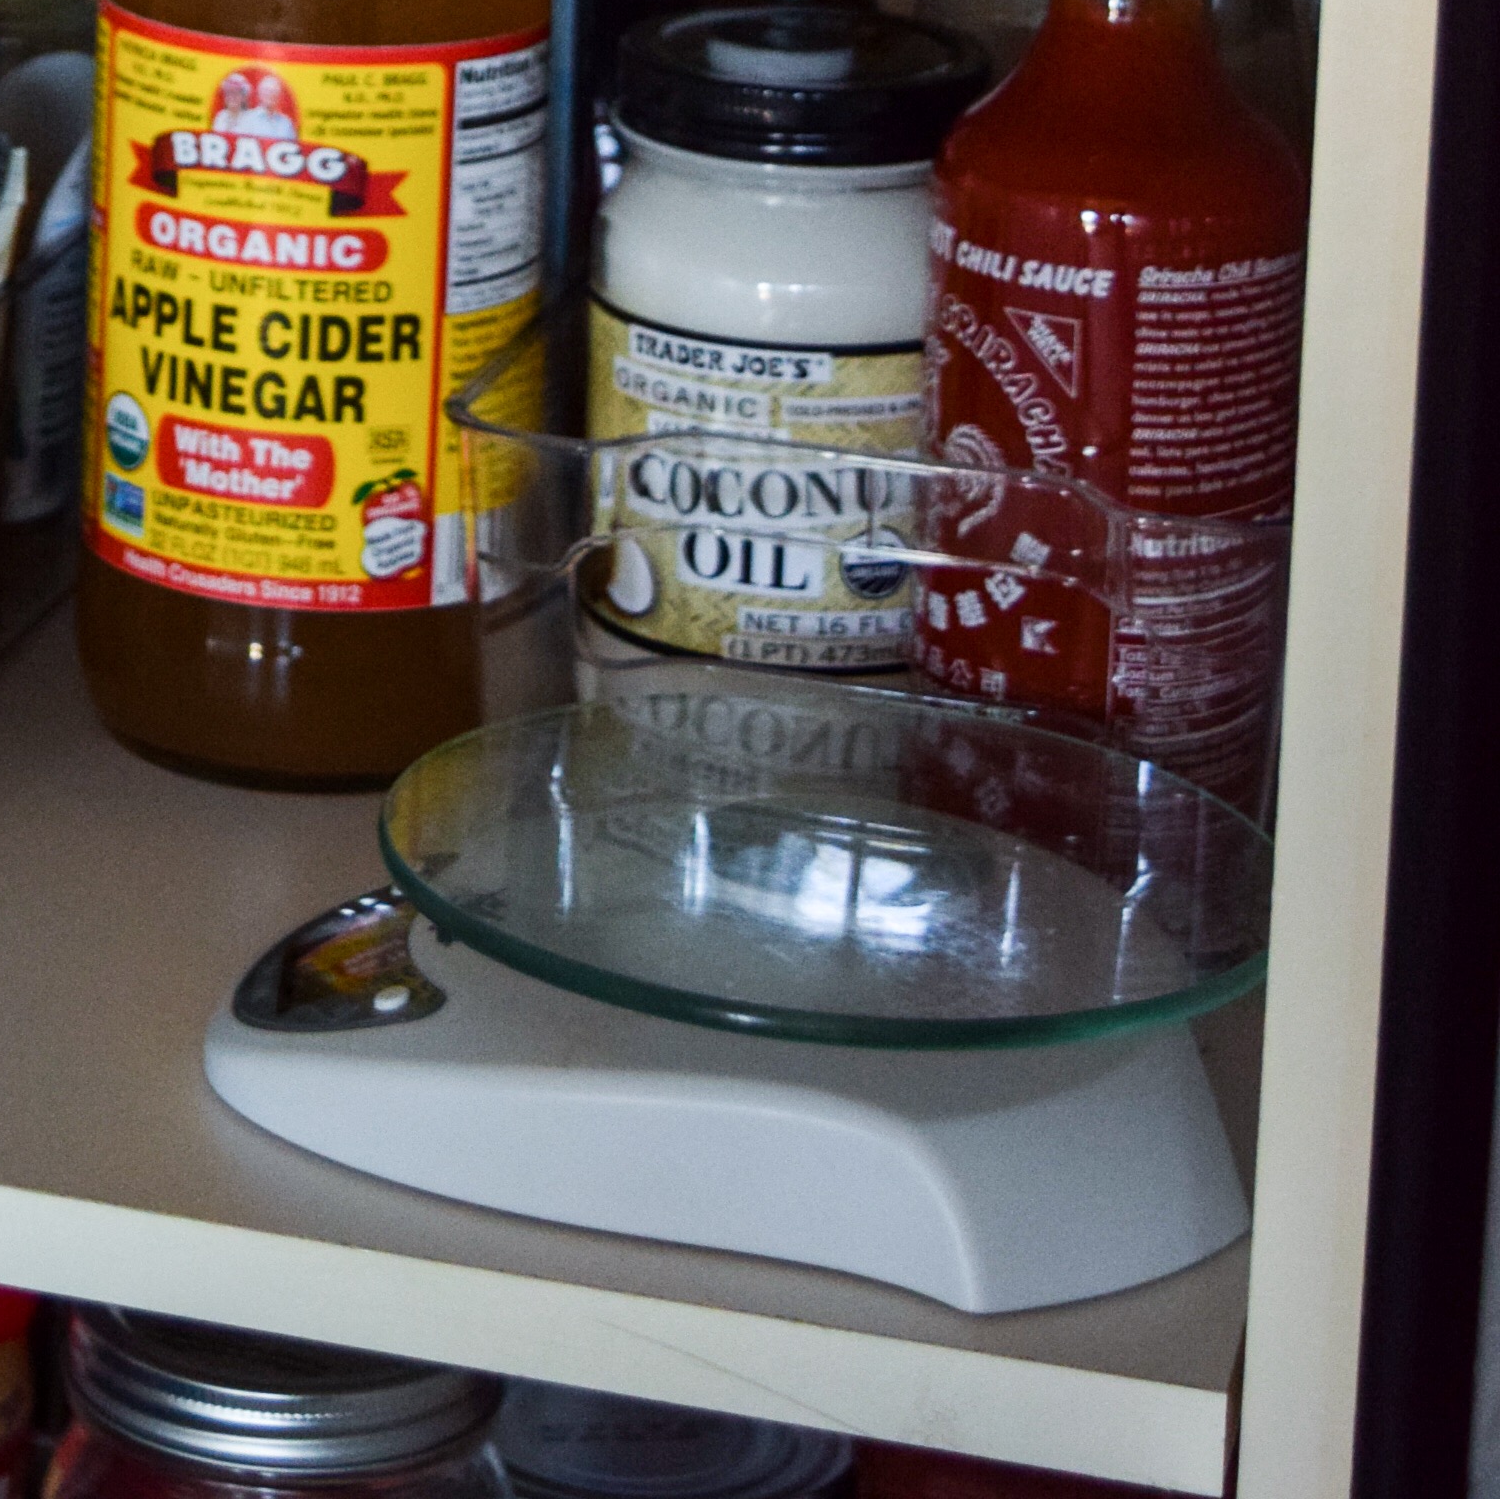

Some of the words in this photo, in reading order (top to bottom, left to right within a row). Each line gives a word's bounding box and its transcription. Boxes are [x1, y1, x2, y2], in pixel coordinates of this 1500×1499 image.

[170, 130, 348, 182] BRAGG
[150, 210, 365, 269] ORGANIC
[130, 249, 180, 282] RAW
[208, 267, 394, 304] UNFILTERED
[955, 239, 1019, 282] CHILI
[1018, 259, 1116, 299] SAUCE
[110, 275, 239, 354] APPLE
[258, 310, 422, 363] CIDER
[634, 331, 725, 372] TRADER
[731, 355, 812, 380] JOE'S
[140, 345, 367, 424] VINEGAR
[615, 365, 758, 420] ORGANIC
[173, 422, 243, 464] With
[250, 436, 314, 472] The
[151, 489, 339, 533] UNPASTEURIZED
[629, 452, 896, 519] COCONU
[154, 511, 219, 540] Naturally
[123, 548, 168, 580] Health
[167, 560, 257, 598] Crusaders
[259, 577, 315, 602] Since
[317, 583, 364, 604] 1912
[682, 529, 810, 592] OIL
[744, 612, 800, 635] NET
[817, 614, 847, 636] 16
[859, 614, 892, 636] FL
[760, 639, 811, 665] PT)
